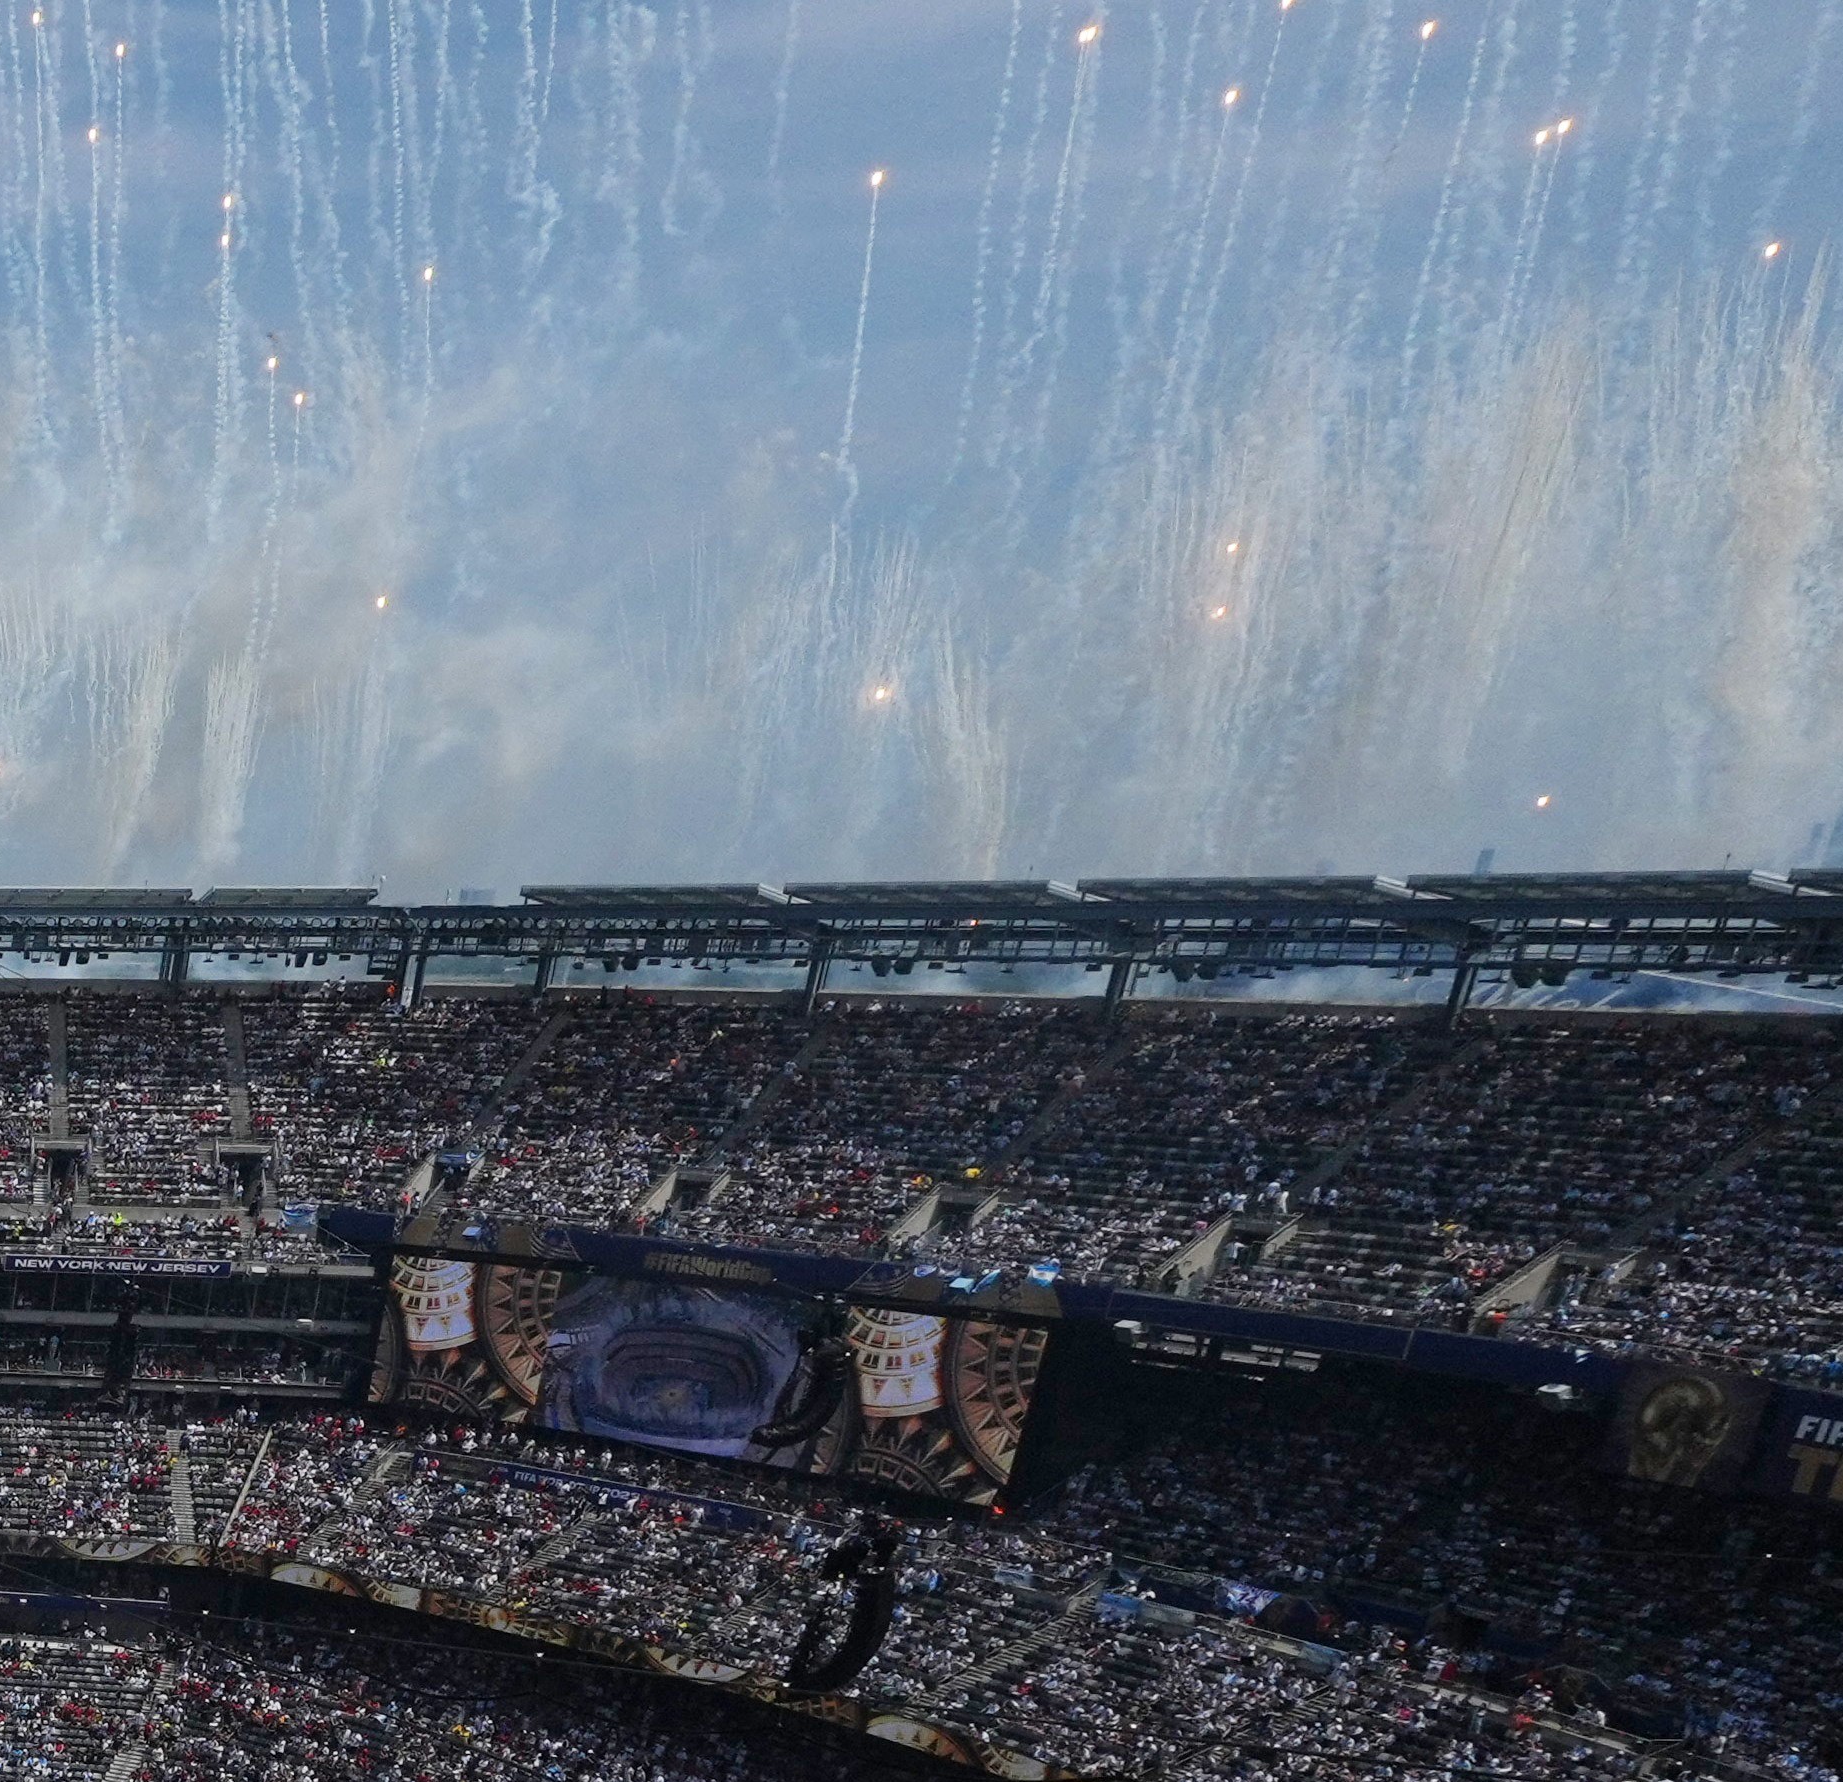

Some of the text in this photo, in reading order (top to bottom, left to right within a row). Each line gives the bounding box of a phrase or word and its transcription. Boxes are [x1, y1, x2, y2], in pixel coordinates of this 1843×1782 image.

[15, 1258, 221, 1274] NEW YORK NEW JERSEY
[1793, 1414, 1843, 1447] FIF
